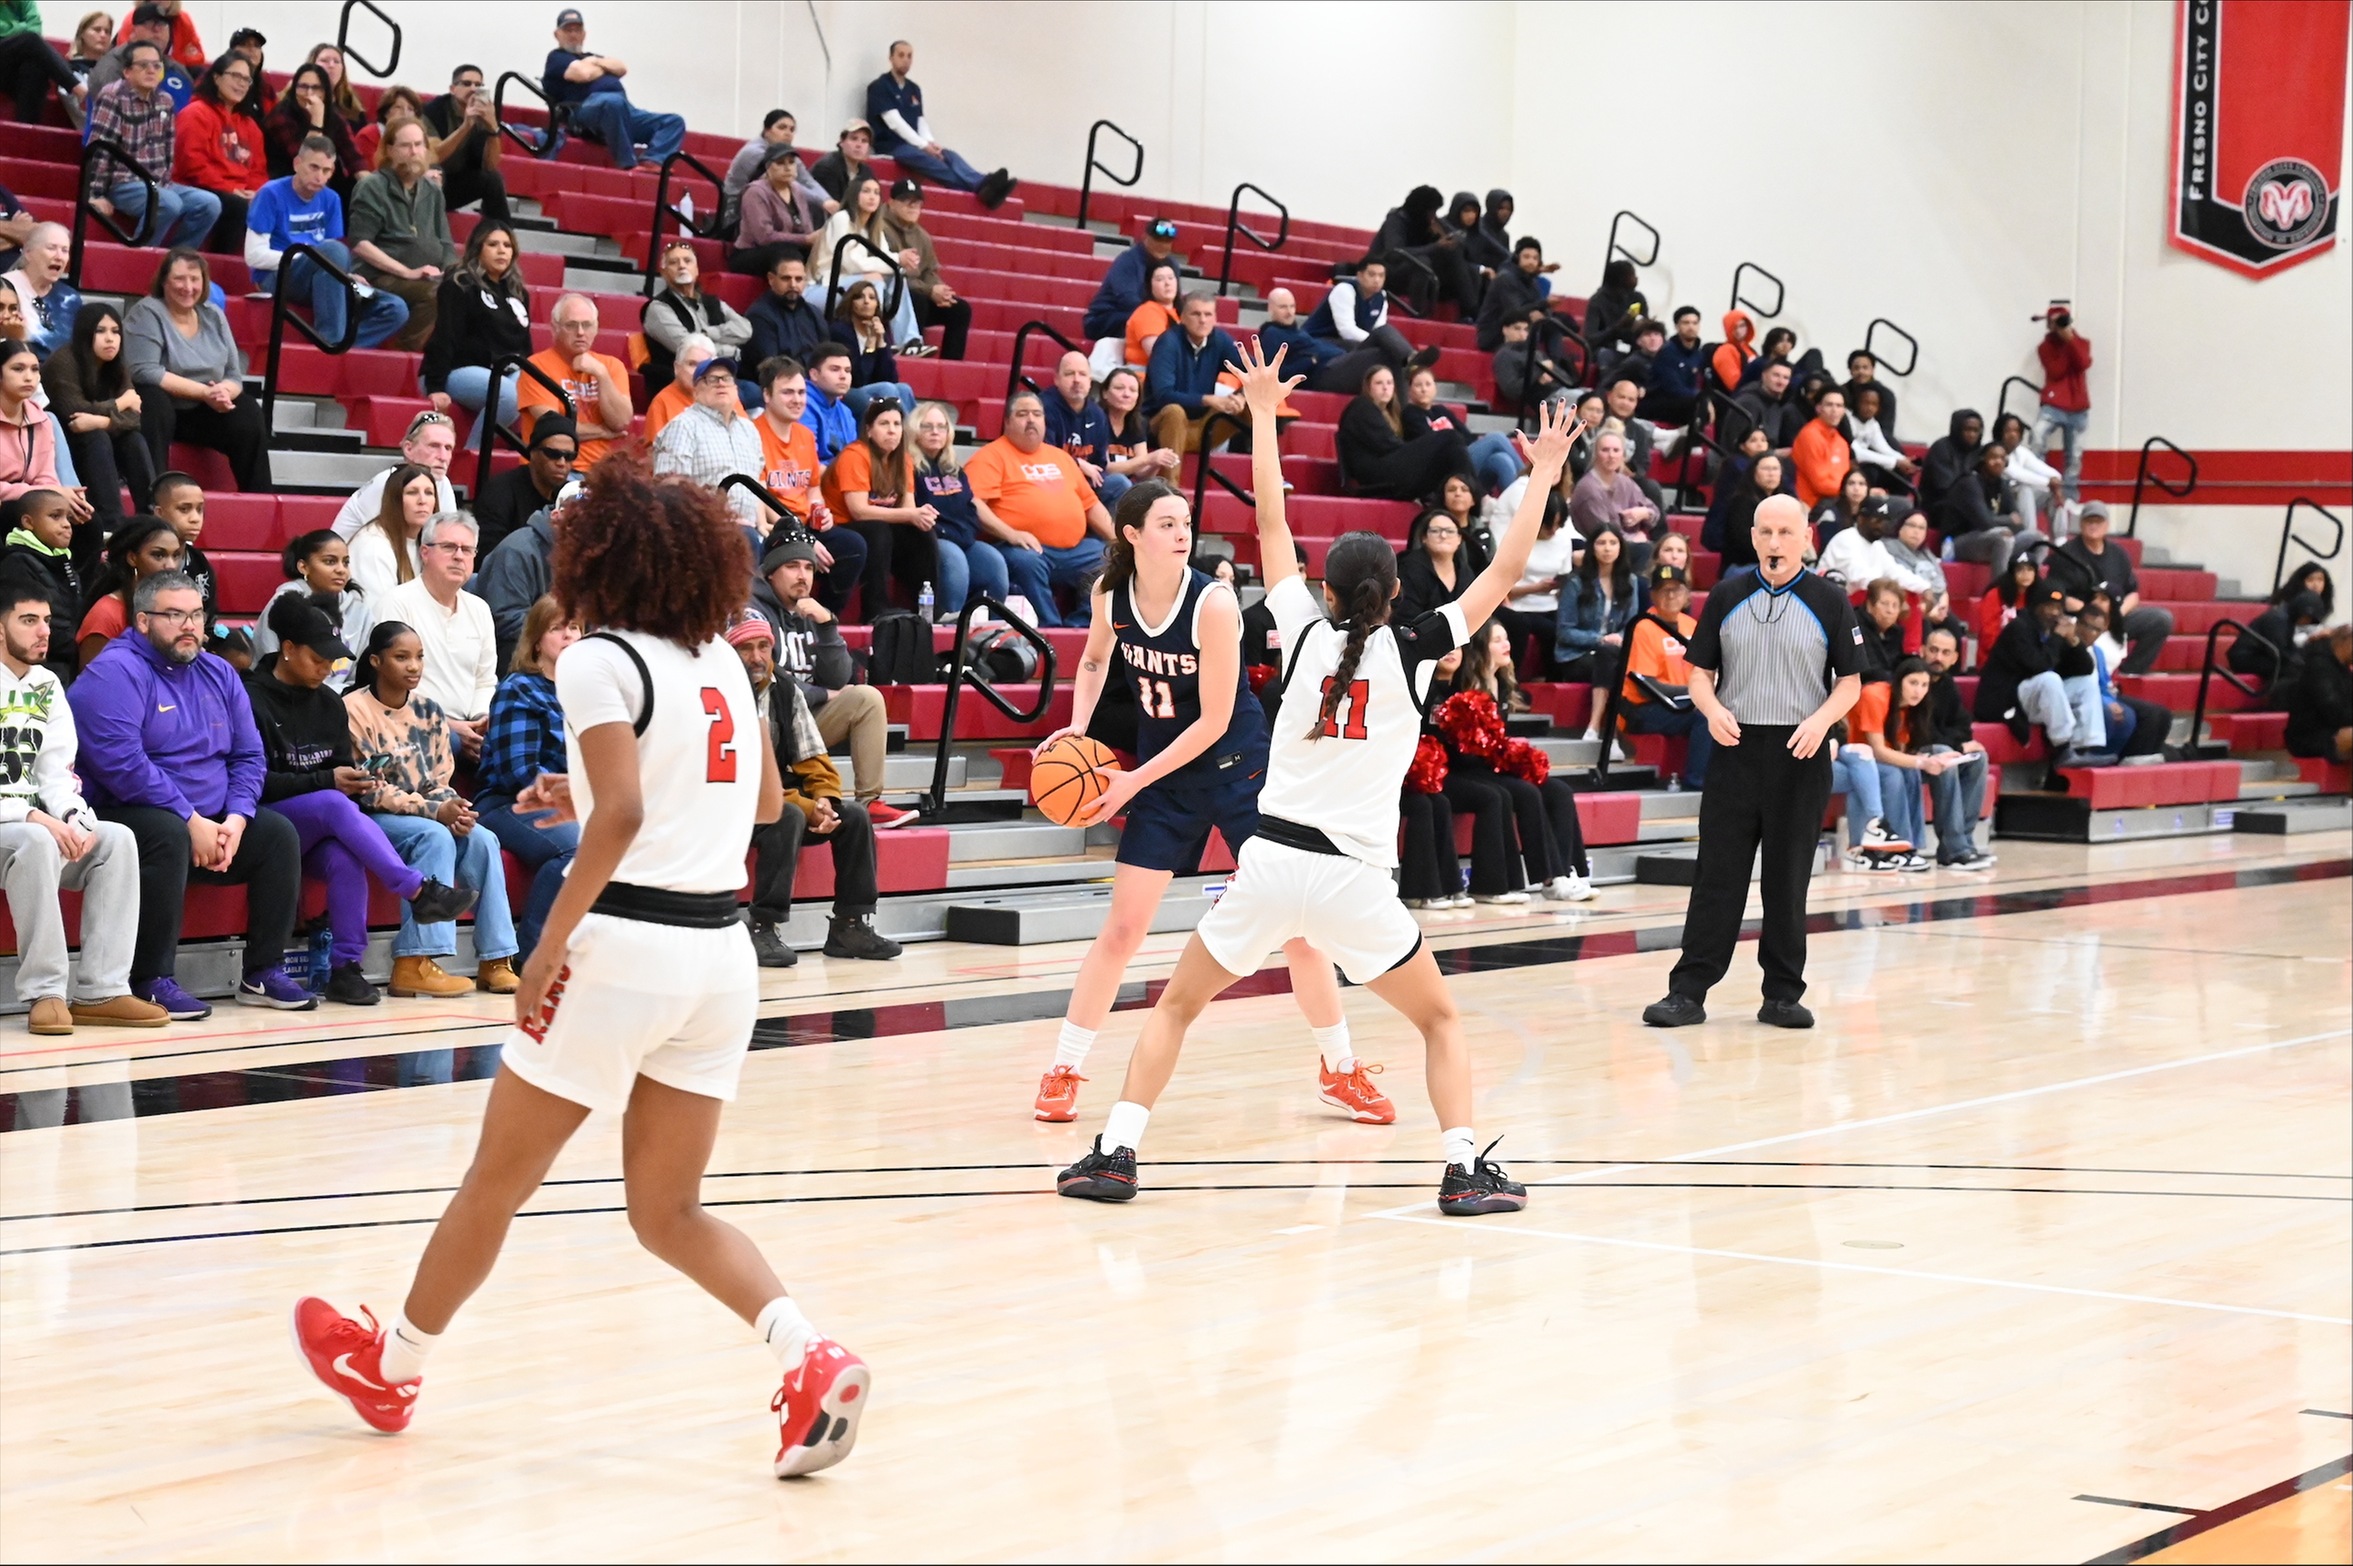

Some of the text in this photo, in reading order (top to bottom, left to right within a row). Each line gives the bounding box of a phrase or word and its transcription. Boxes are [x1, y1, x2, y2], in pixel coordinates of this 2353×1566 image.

[2193, 34, 2209, 92] CITY
[2188, 100, 2208, 201] FRESNO
[700, 687, 736, 783] 2
[1137, 675, 1176, 719] 11
